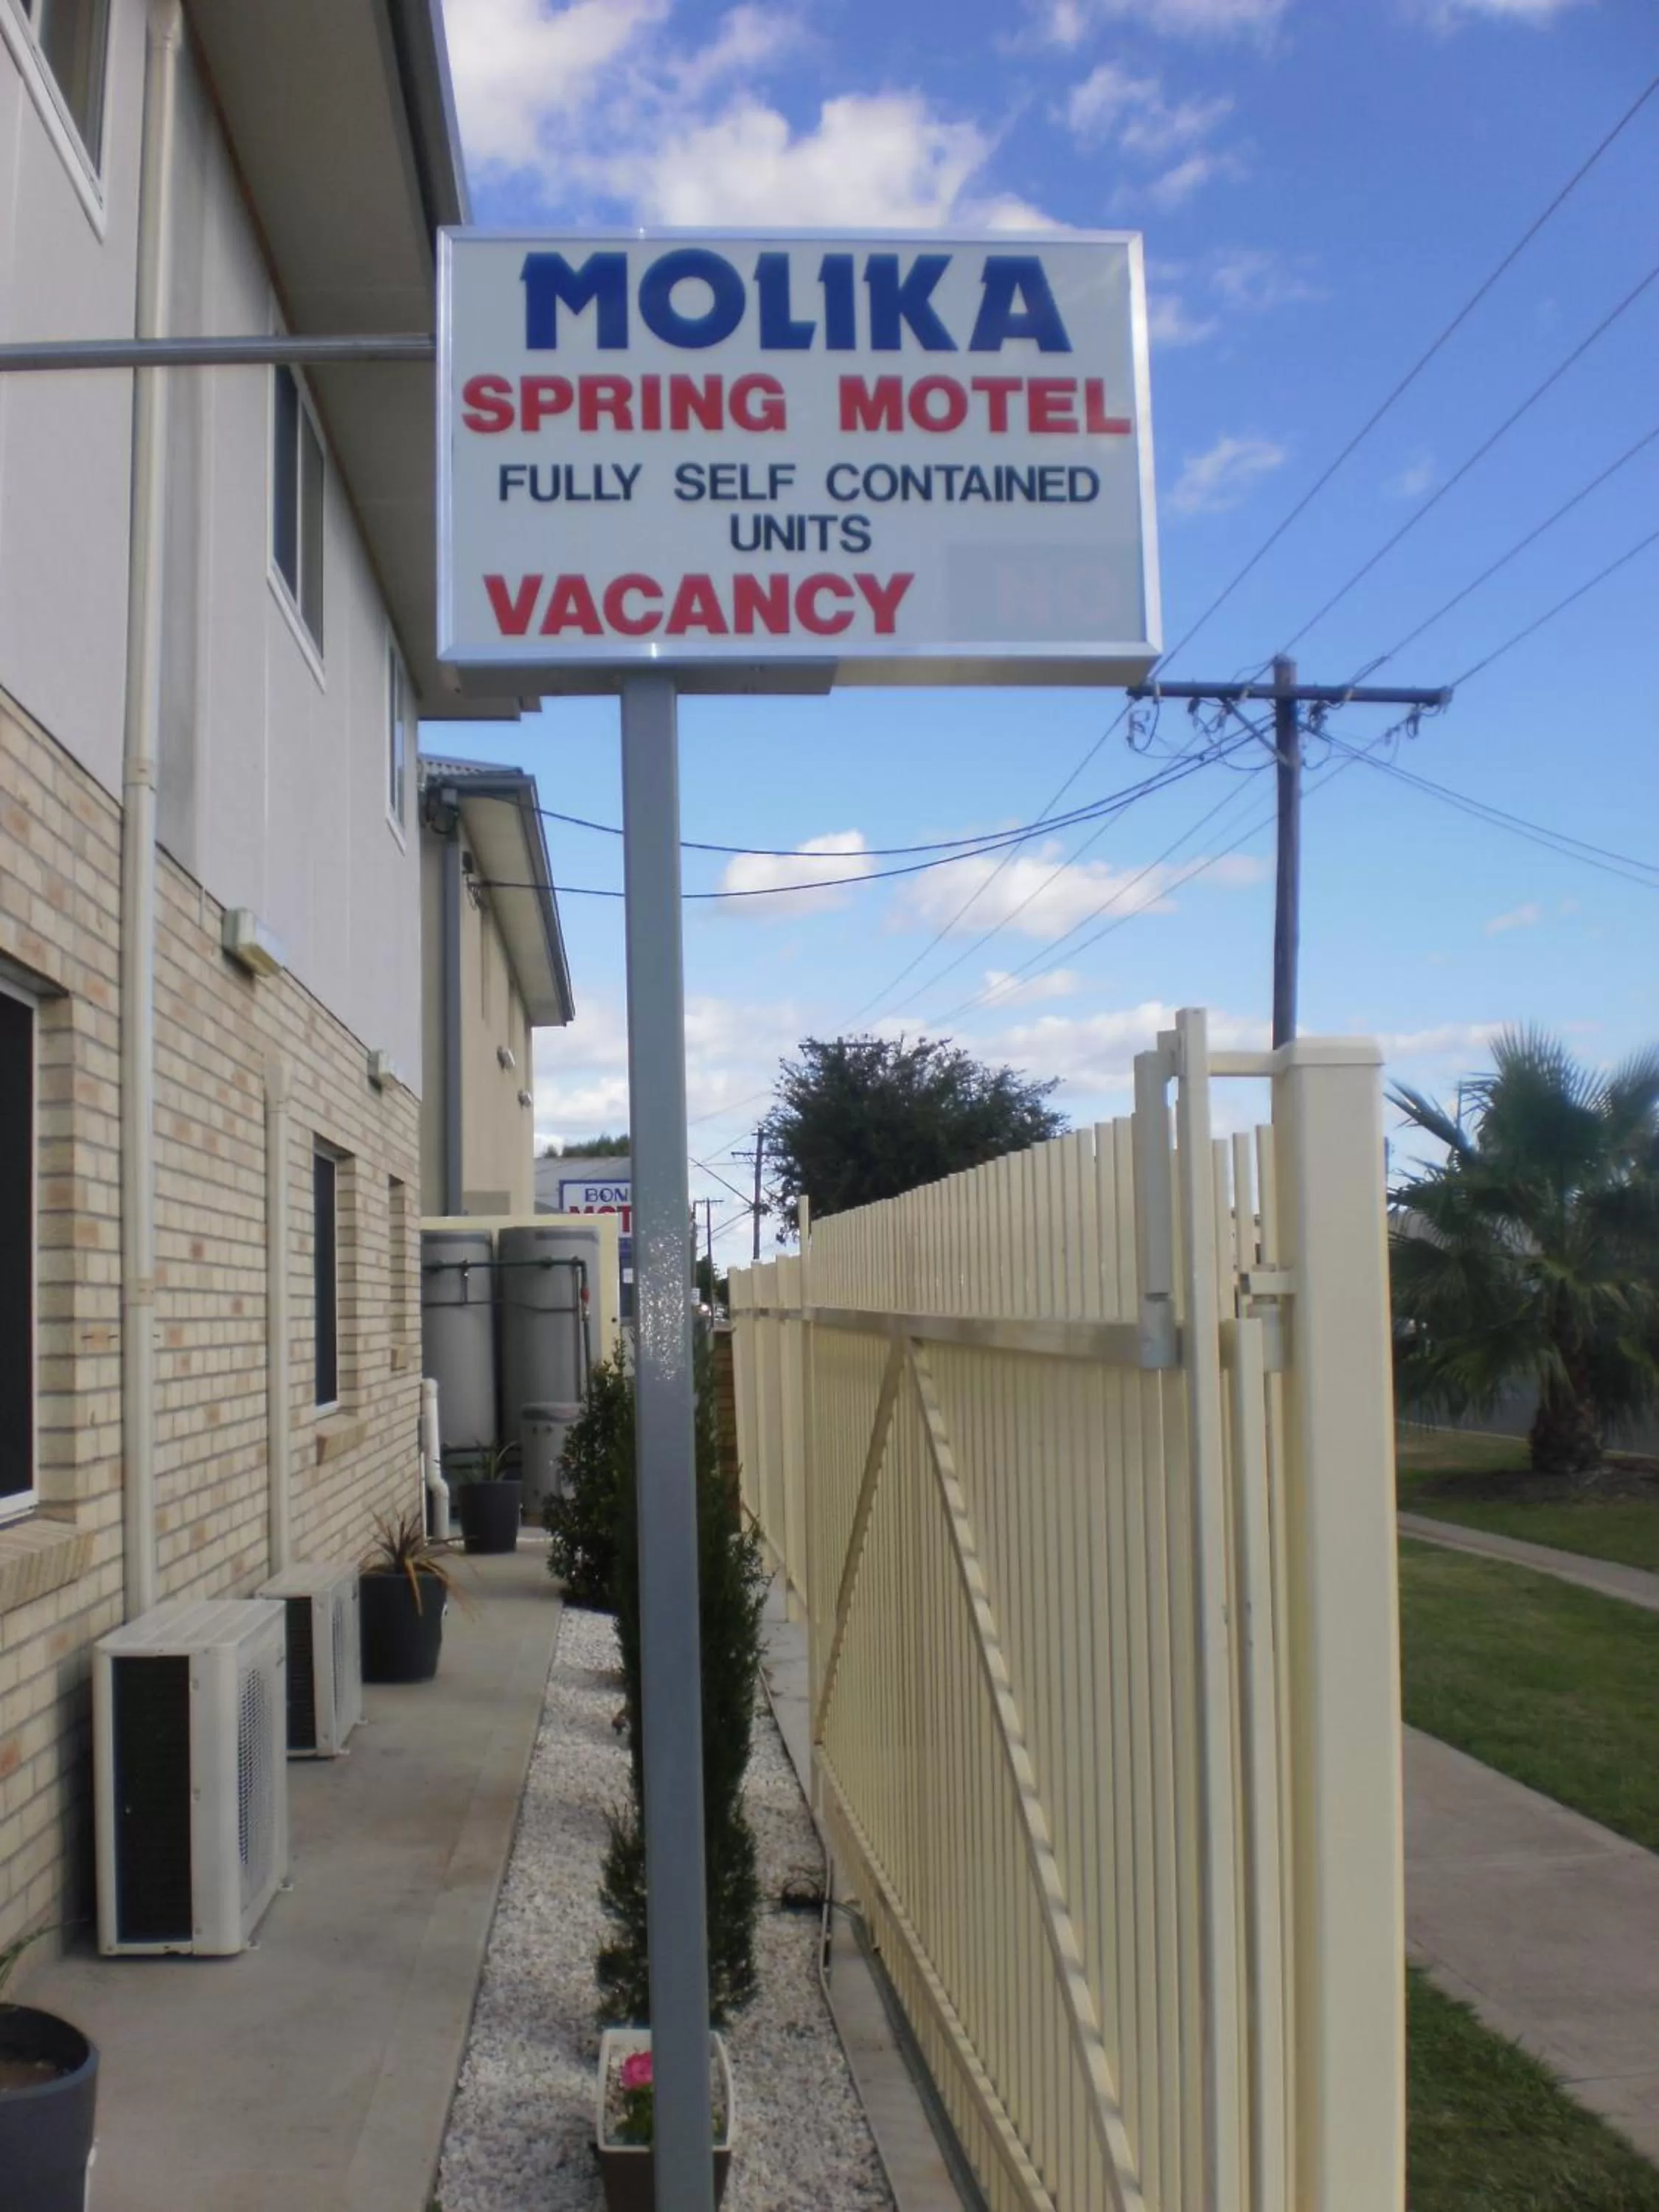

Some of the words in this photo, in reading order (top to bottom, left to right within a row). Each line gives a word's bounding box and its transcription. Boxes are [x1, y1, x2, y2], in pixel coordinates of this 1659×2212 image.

[520, 248, 1073, 353] MOLIKA
[462, 374, 787, 434] SPRING
[839, 376, 1131, 434] MOTEL
[499, 464, 641, 503] FULLY
[674, 463, 796, 502] SELF
[827, 464, 1099, 504] CONTAINED
[731, 514, 872, 554] UNITS
[484, 573, 915, 636] VACANCY
